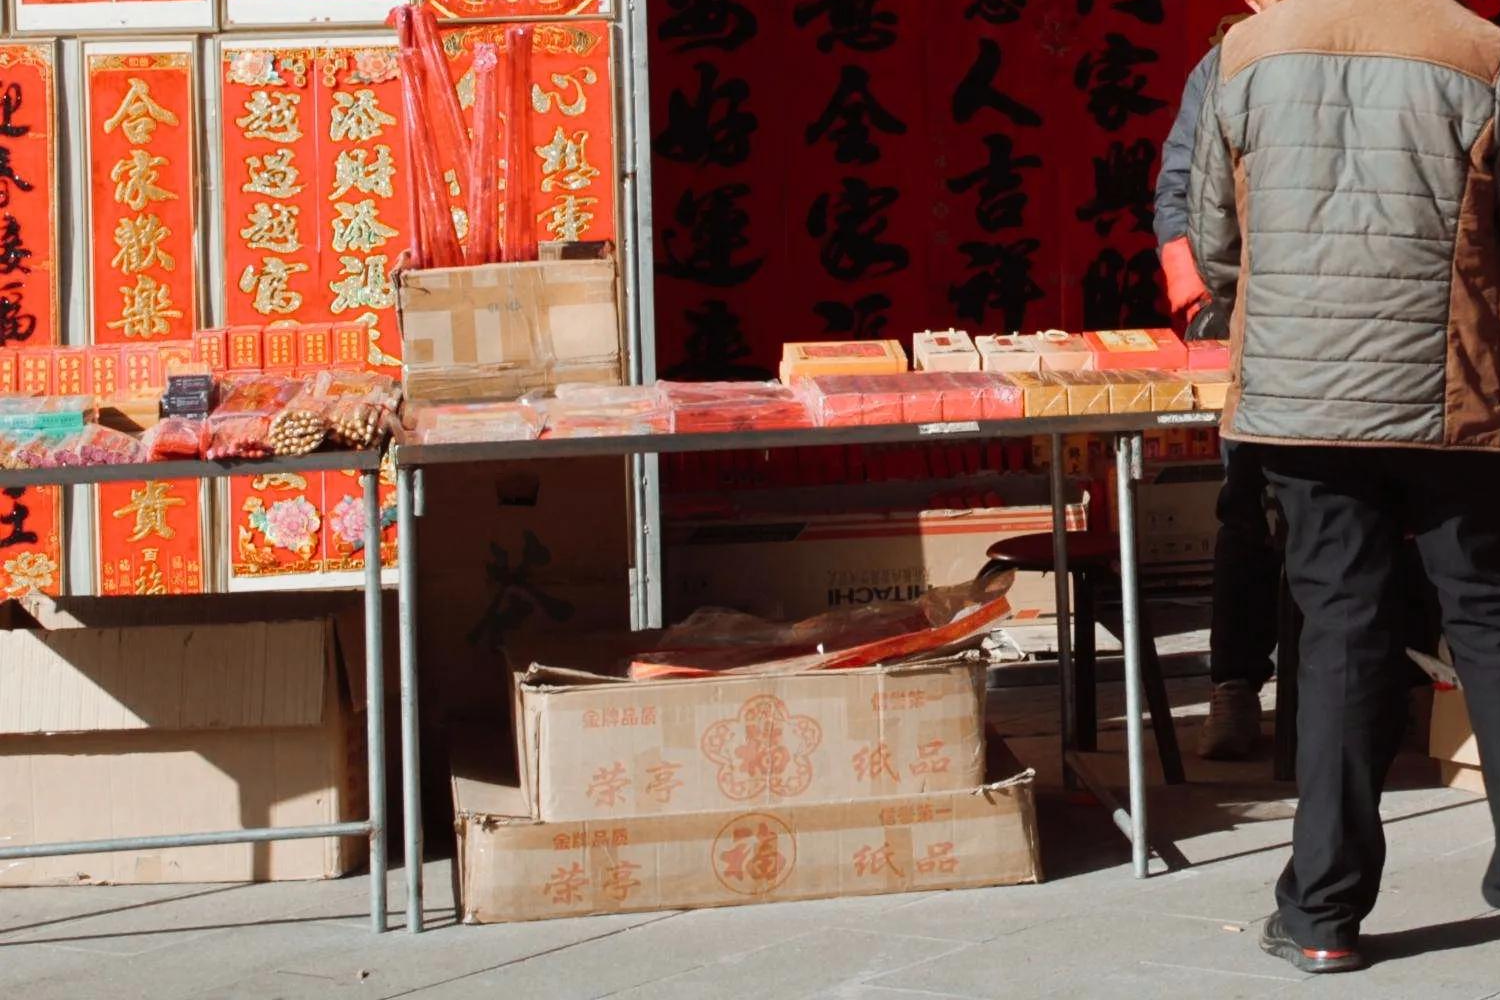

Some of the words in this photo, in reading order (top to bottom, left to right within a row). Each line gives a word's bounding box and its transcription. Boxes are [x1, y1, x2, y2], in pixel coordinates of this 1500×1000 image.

[581, 706, 657, 729] 金牌品质
[552, 827, 630, 851] 金牌品质
[720, 821, 787, 883] 福
